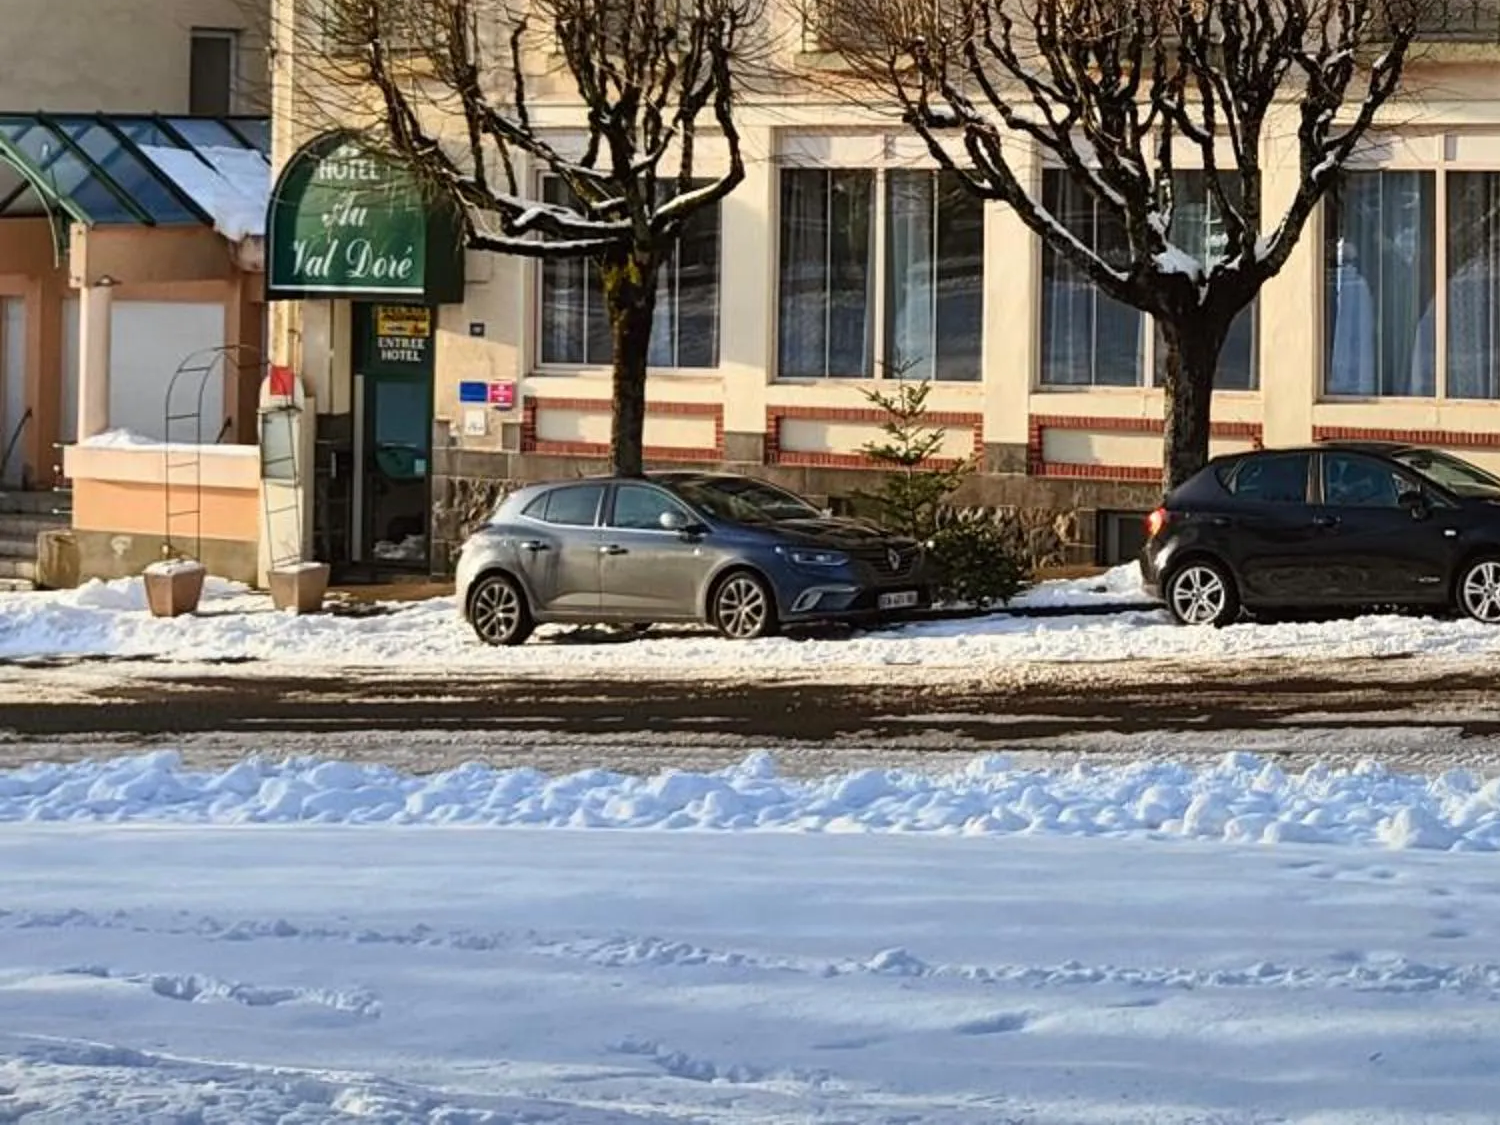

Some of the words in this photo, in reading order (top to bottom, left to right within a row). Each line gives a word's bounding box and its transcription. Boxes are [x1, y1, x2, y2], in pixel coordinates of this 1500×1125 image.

[321, 191, 368, 227] Au
[291, 238, 339, 279] Val
[345, 238, 413, 280] Doré
[380, 349, 421, 362] HOTEL
